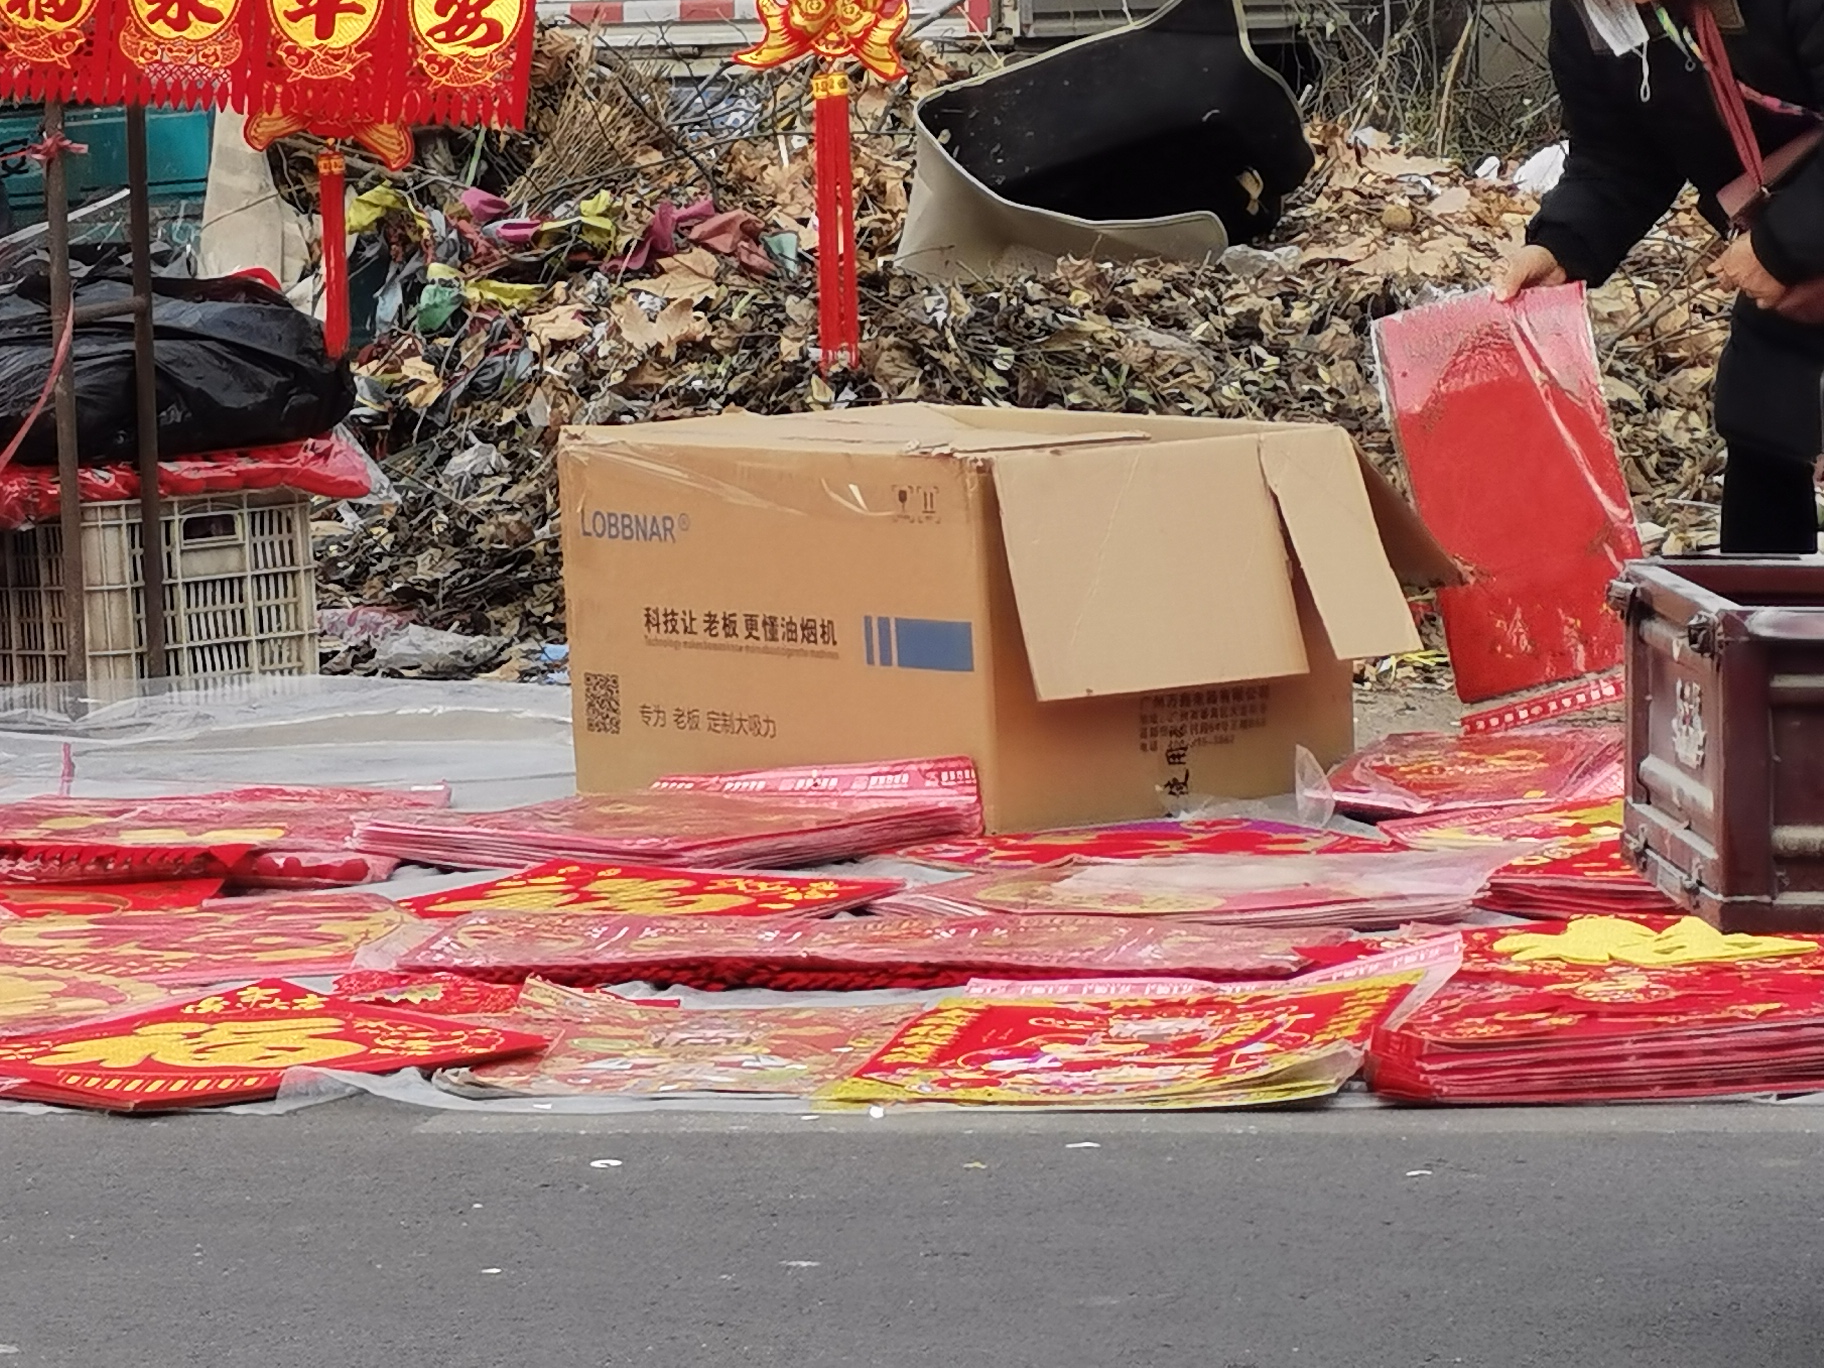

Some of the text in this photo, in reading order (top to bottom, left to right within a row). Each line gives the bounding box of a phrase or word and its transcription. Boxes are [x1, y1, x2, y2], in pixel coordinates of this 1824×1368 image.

[580, 508, 676, 544] LOBBNAR
[643, 607, 838, 647] 科技让 老板 更懂油烟机
[638, 703, 777, 740] 专为 老板 定制大吸力
